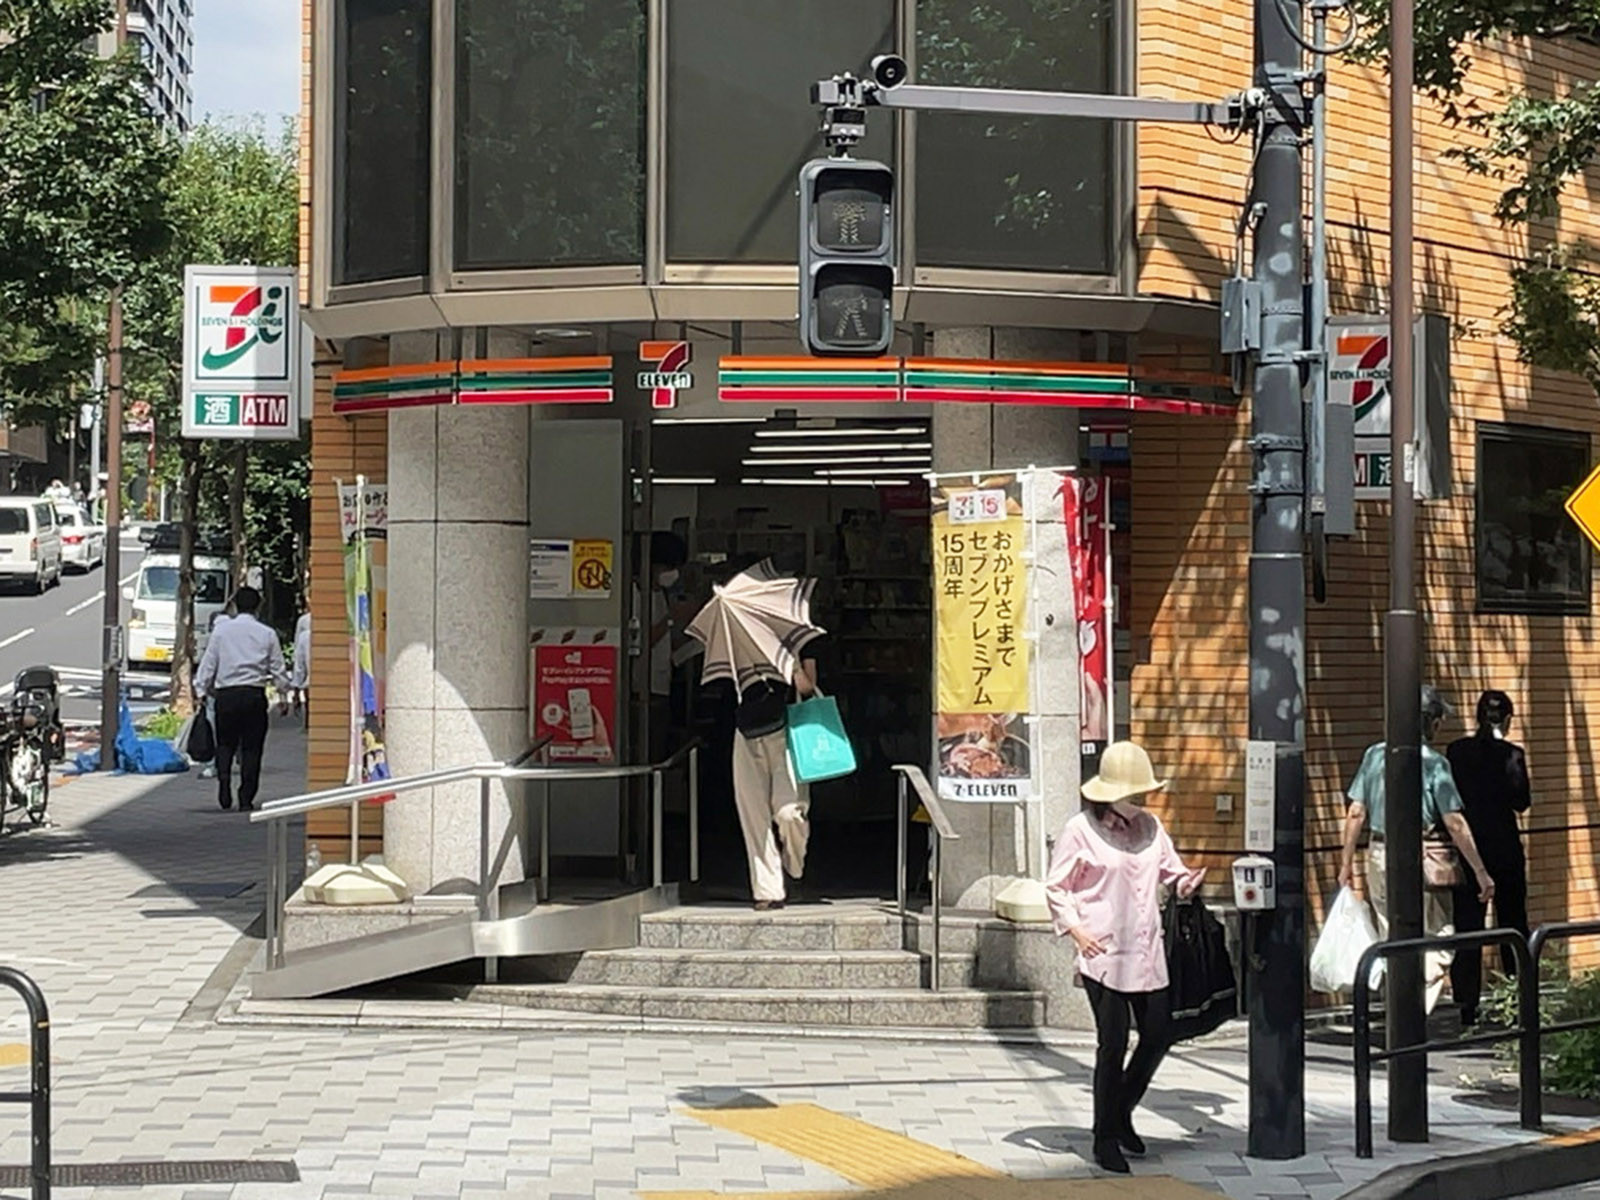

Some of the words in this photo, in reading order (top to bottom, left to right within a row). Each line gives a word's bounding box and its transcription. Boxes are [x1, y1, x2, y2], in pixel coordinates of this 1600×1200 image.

[204, 397, 232, 424] 酒
[243, 397, 286, 424] ATM
[980, 496, 999, 514] 15
[940, 533, 965, 599] 15周年
[968, 531, 993, 706] セブンプレミアム
[991, 530, 1016, 667] おかげさまで
